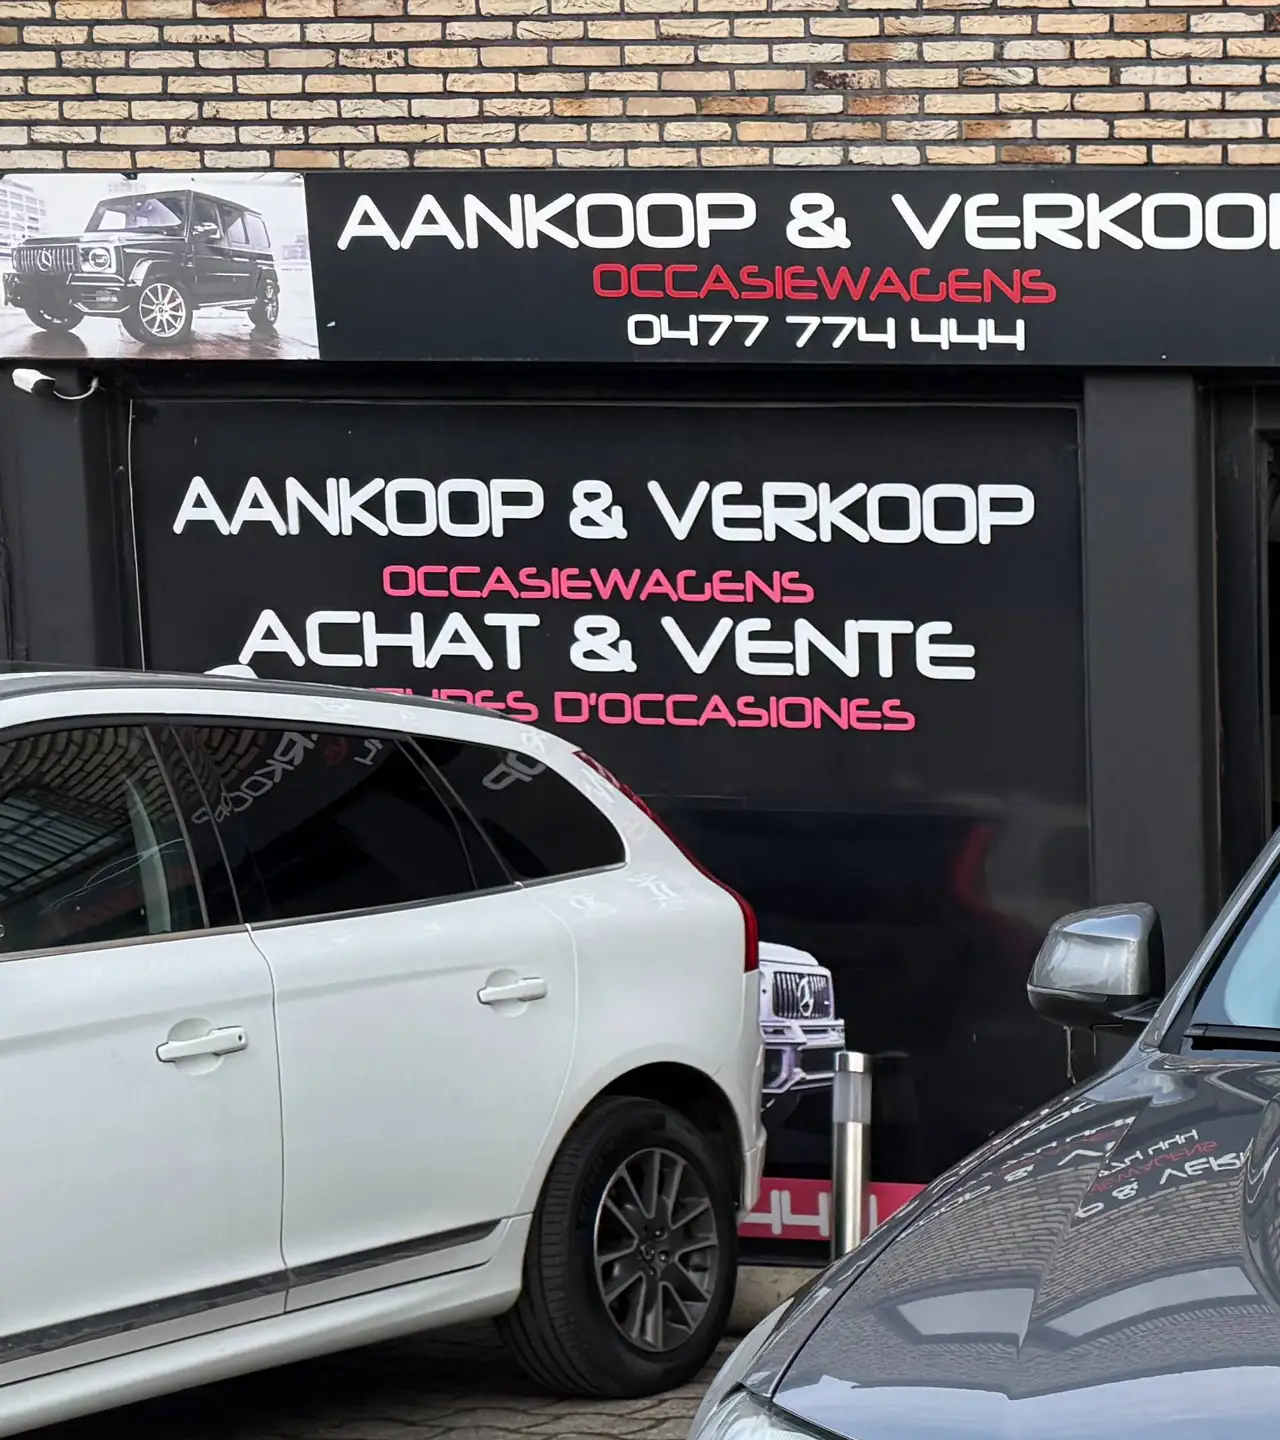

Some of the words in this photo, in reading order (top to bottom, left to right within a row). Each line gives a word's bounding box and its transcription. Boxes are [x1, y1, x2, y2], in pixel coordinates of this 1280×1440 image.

[335, 191, 758, 252] AANKOOP
[784, 191, 853, 250] &
[592, 262, 1058, 306] OCCASIEWAGENS
[626, 312, 769, 348] 0477
[784, 314, 897, 351] 774
[909, 316, 1026, 352] 444
[171, 474, 546, 539] AANKOOP
[568, 478, 629, 541] &
[646, 479, 1036, 546] VERKOOP
[382, 564, 816, 605] OCCASIEWAGENS
[237, 607, 542, 671] ACHAT
[568, 613, 639, 674] &
[659, 614, 977, 681] VENTE
[553, 690, 917, 733] D'OCCASIONES
